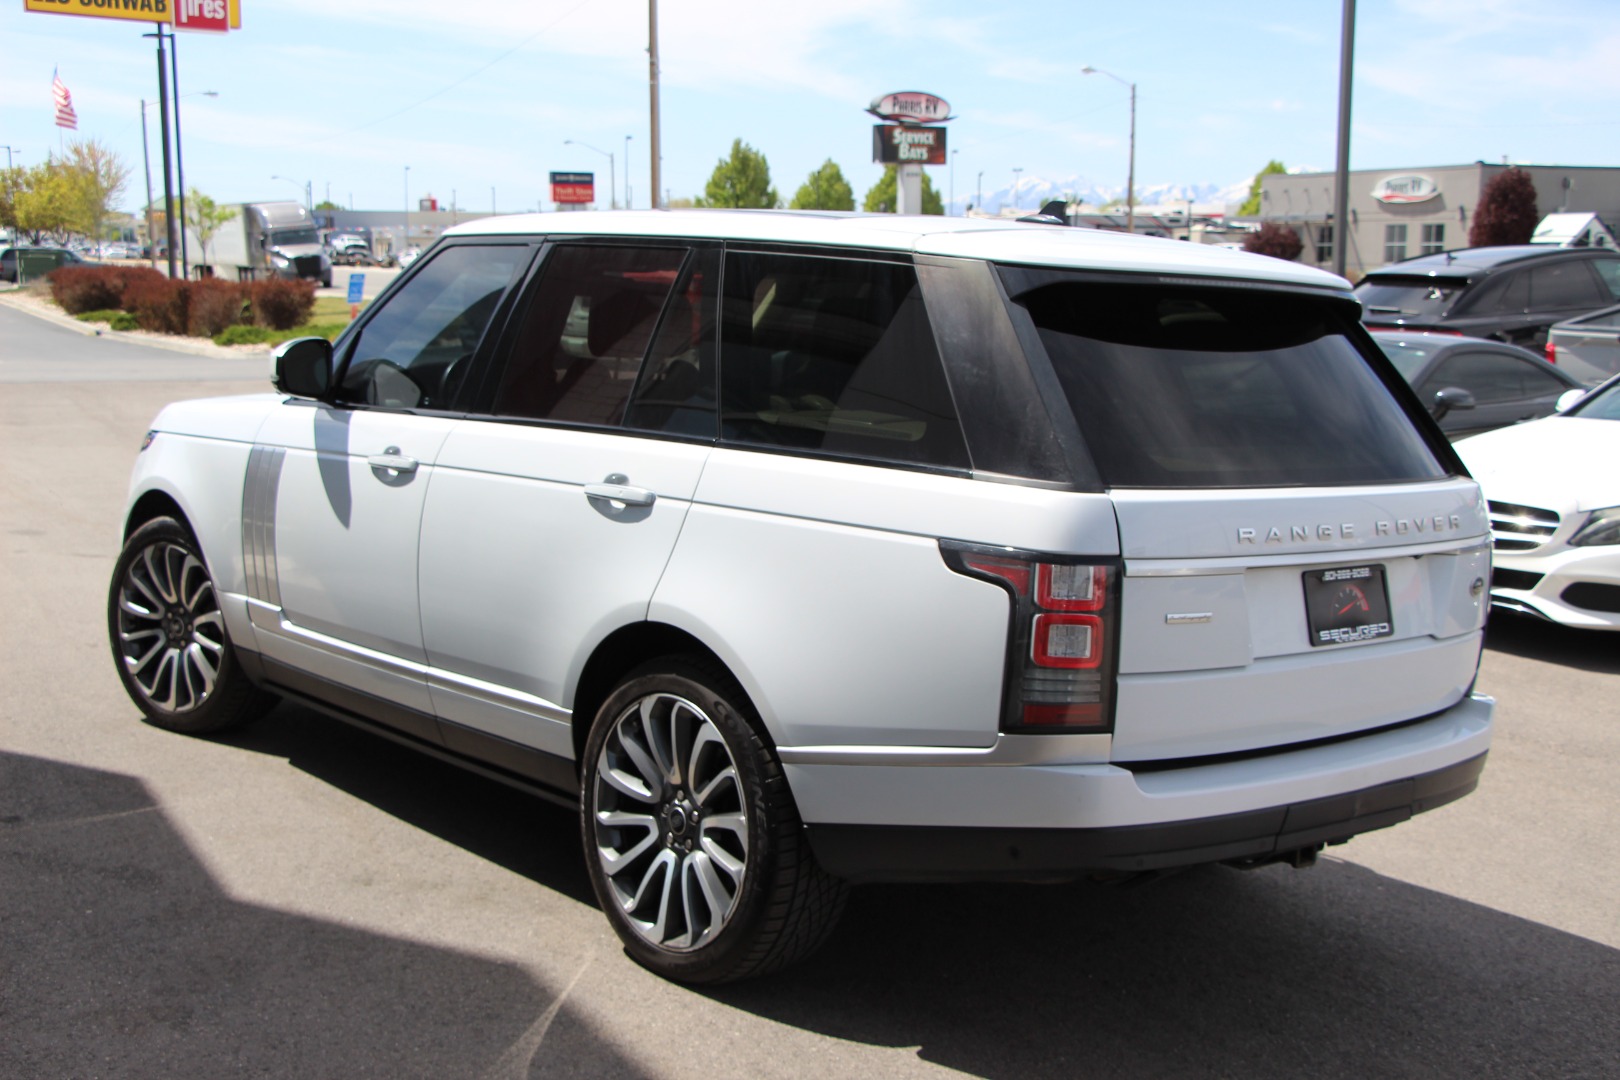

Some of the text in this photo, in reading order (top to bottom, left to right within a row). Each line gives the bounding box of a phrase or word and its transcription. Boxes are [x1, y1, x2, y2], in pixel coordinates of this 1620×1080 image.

[925, 97, 939, 114] RV
[1411, 176, 1422, 192] RV
[1237, 515, 1461, 544] RANGE ROVER
[1319, 622, 1389, 641] SECURED
